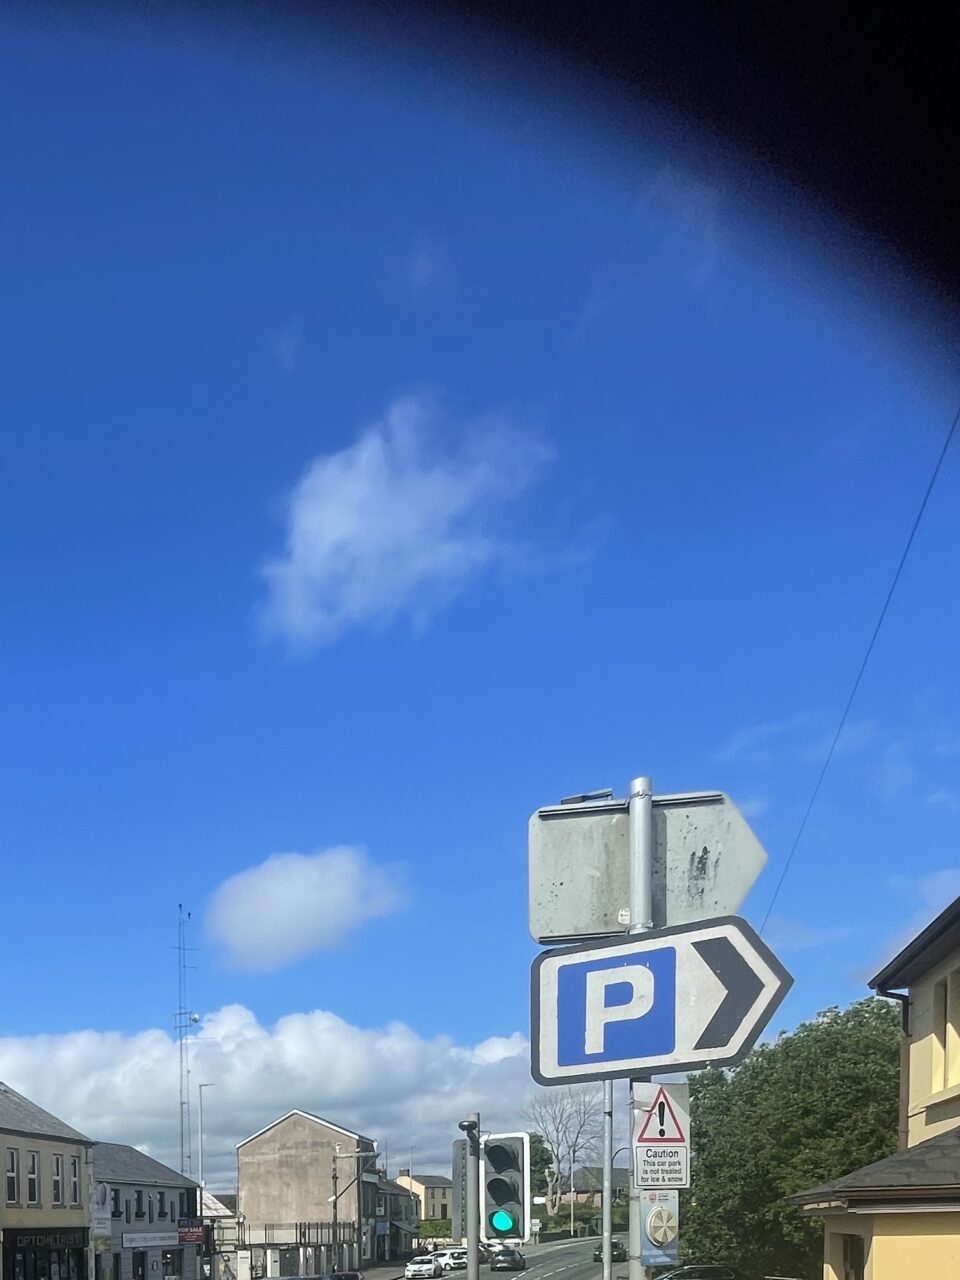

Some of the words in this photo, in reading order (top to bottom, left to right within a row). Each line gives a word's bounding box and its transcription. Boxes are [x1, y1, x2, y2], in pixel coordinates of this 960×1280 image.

[585, 964, 655, 1055] P
[645, 1148, 680, 1159] Caution
[642, 1159, 656, 1167] This
[668, 1159, 682, 1168] park
[640, 1175, 650, 1183] for
[651, 1175, 660, 1183] ice
[661, 1175, 666, 1183] &
